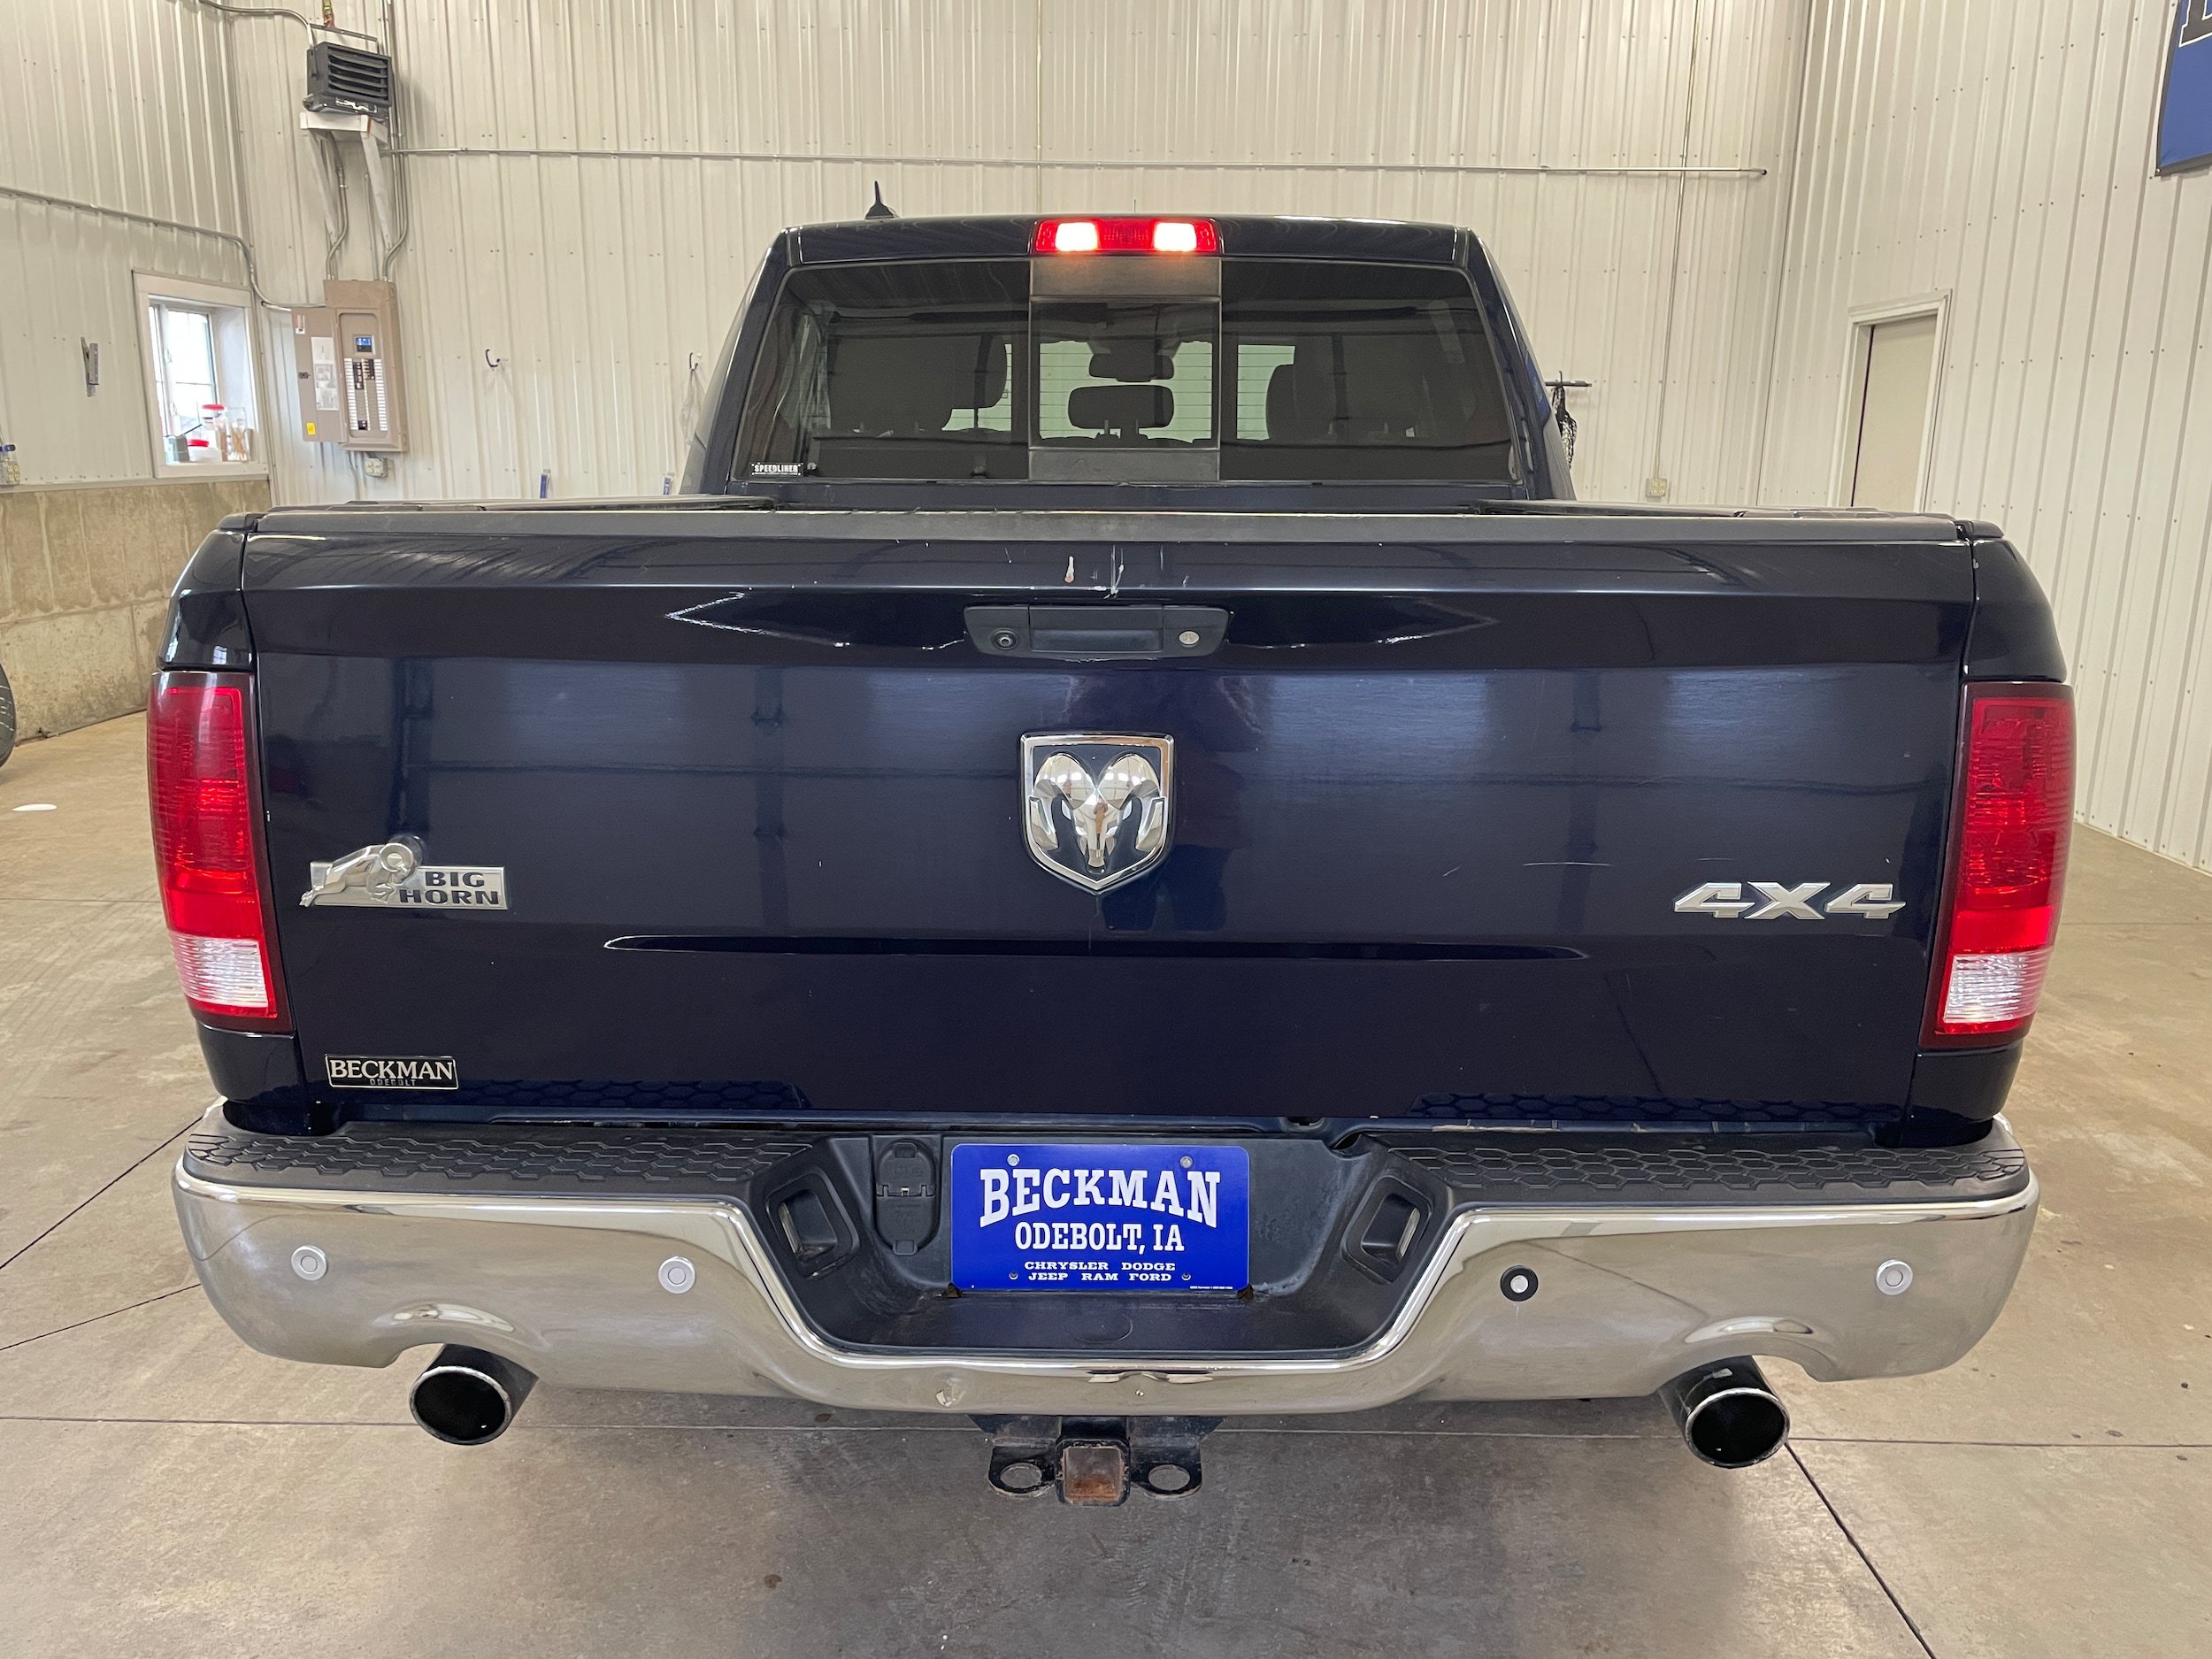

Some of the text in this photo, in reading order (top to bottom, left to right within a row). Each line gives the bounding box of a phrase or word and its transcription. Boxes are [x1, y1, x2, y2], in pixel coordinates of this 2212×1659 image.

[425, 871, 485, 887] BIG
[398, 888, 499, 905] HORN
[1673, 880, 1907, 920] 4X4
[329, 1059, 453, 1080] BECKMAN
[979, 1167, 1221, 1229] BECKMAN
[1014, 1221, 1185, 1255] ODEBOLT, IA
[1024, 1261, 1176, 1271] CHRYSLER DODGE
[1027, 1271, 1172, 1282] JEEP RAM FORD
